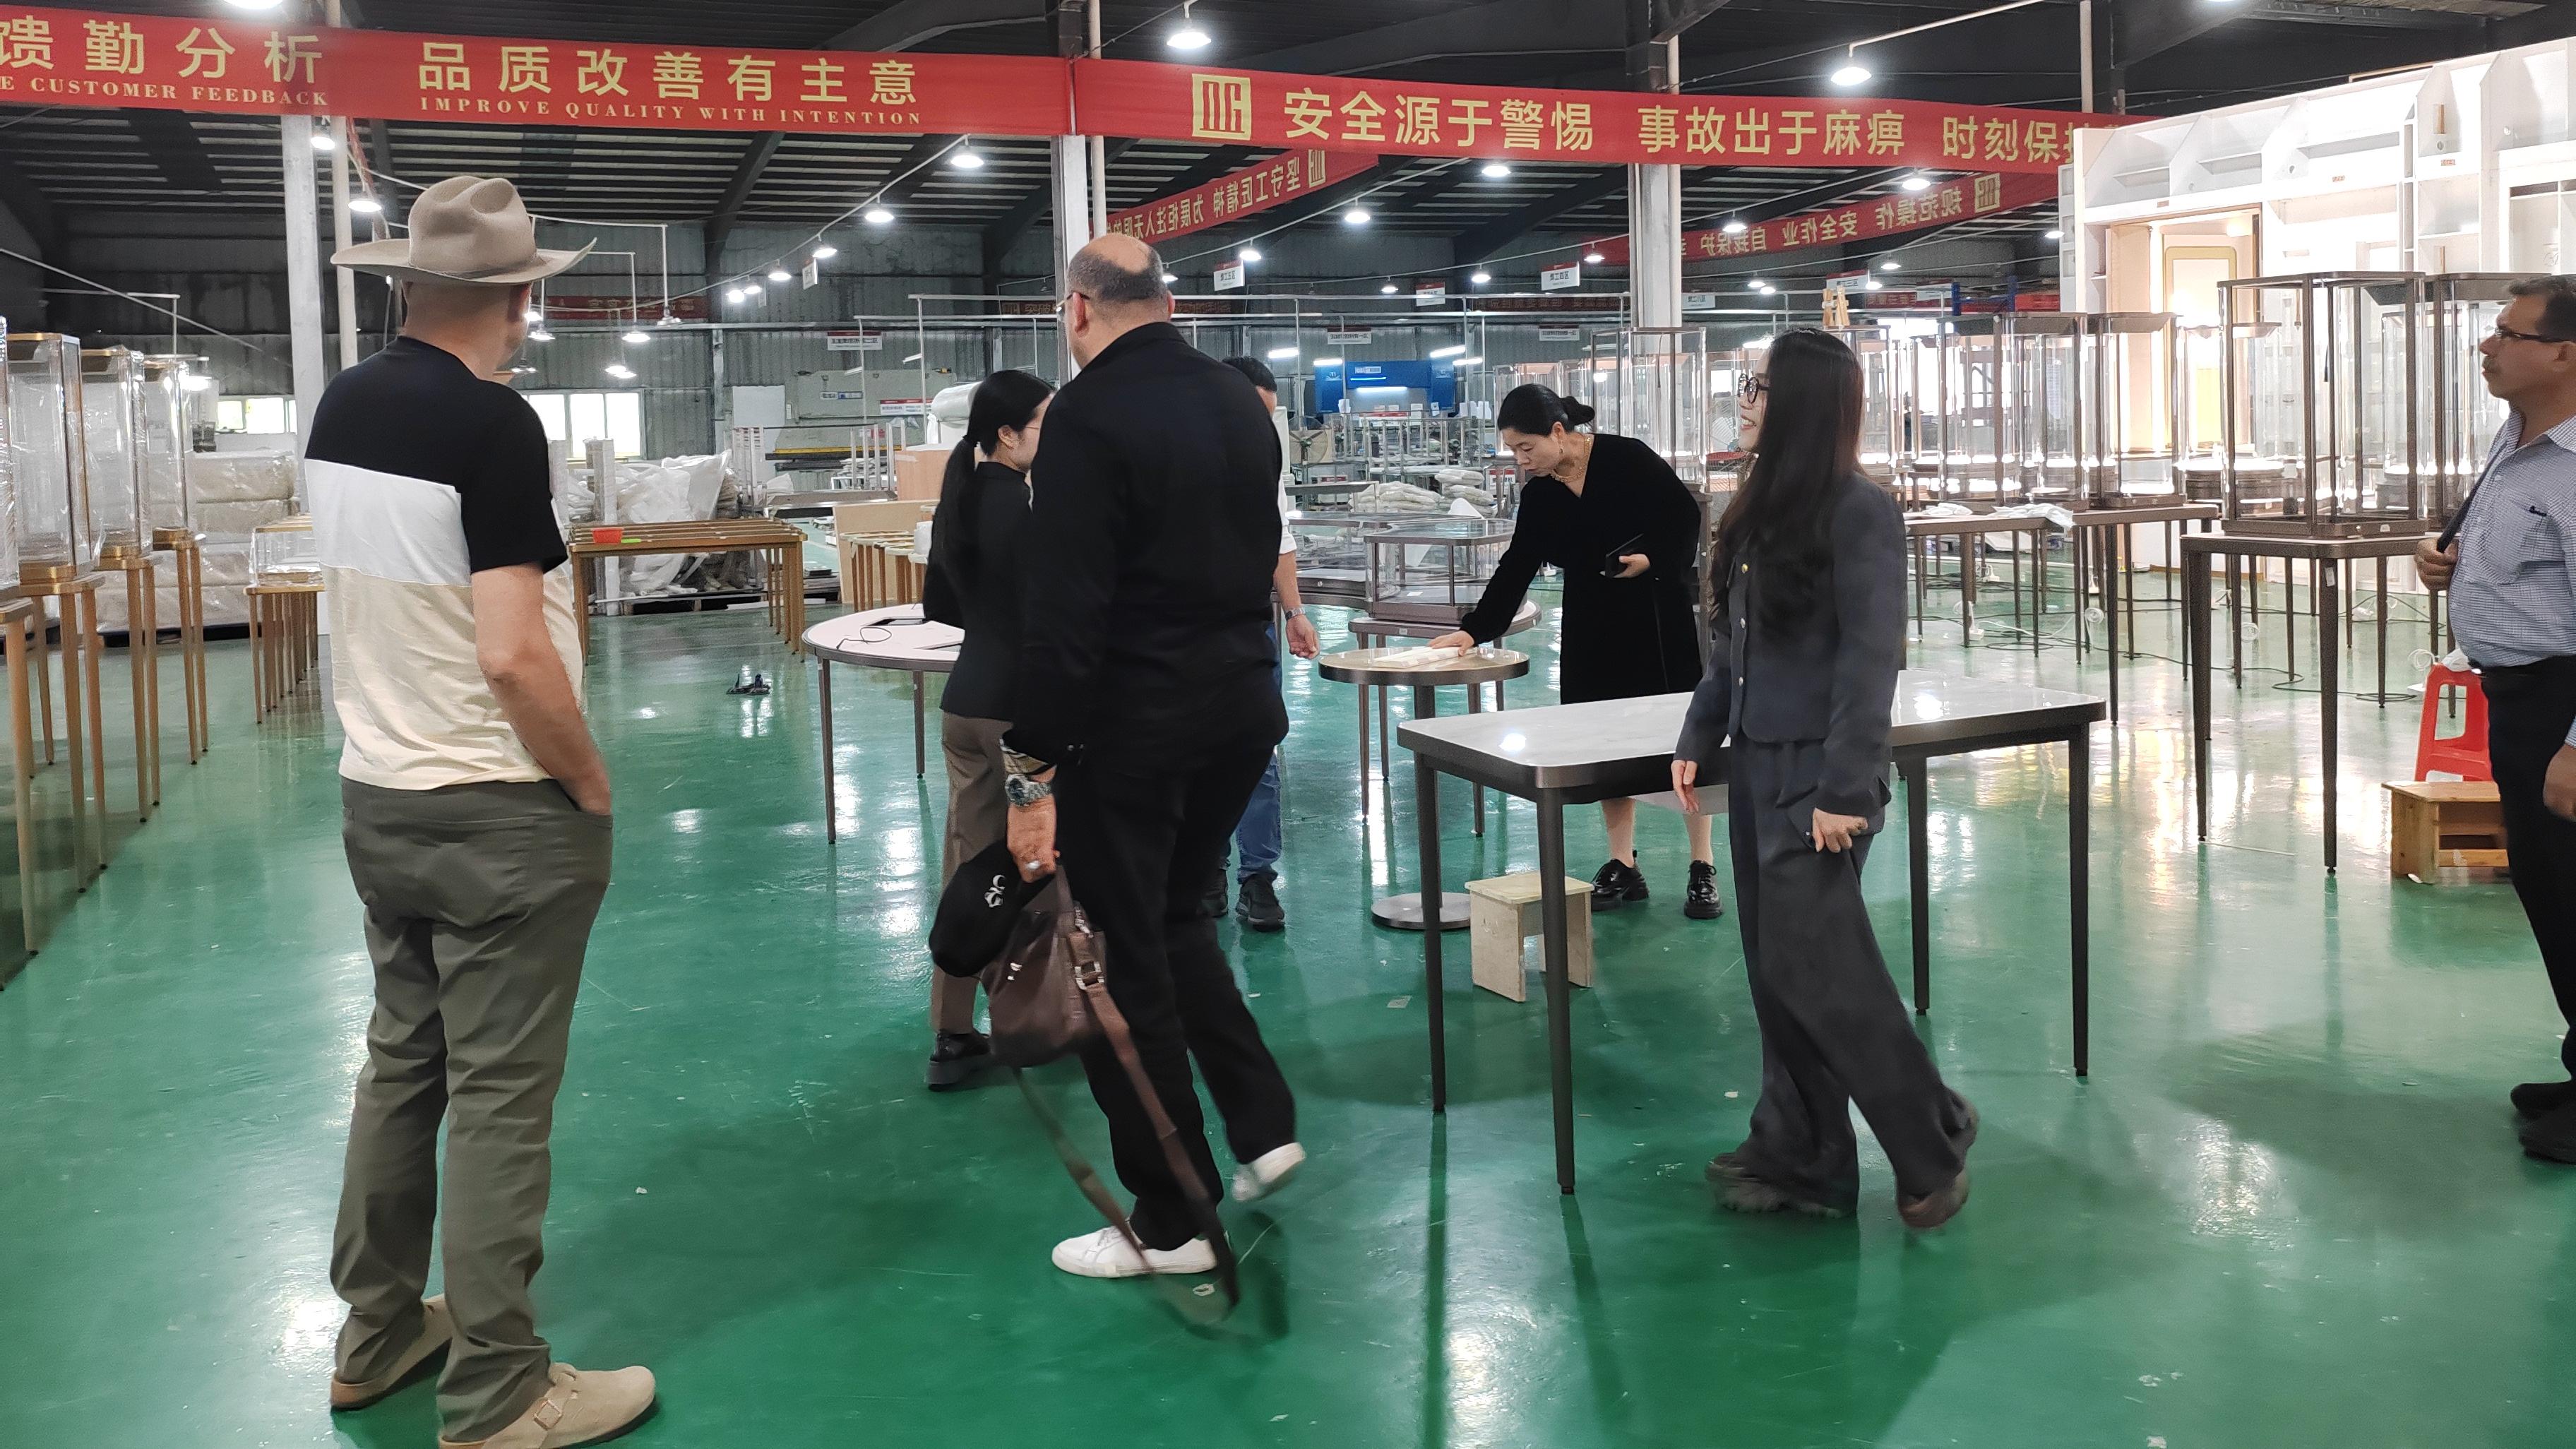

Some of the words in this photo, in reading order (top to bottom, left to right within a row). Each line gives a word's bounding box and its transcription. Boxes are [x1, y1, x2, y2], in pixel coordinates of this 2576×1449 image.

[30, 78, 177, 98] CUSTOMER
[191, 86, 328, 105] FEEDBACK
[419, 42, 916, 105] 品质改善有主意
[421, 97, 549, 114] IMPROVE
[566, 102, 684, 119] QUALITY
[699, 107, 765, 121] WITH
[780, 109, 920, 124] INTENTION
[1284, 87, 1593, 150] 安全源于警惕
[1638, 105, 1904, 155] 事故出于麻痹
